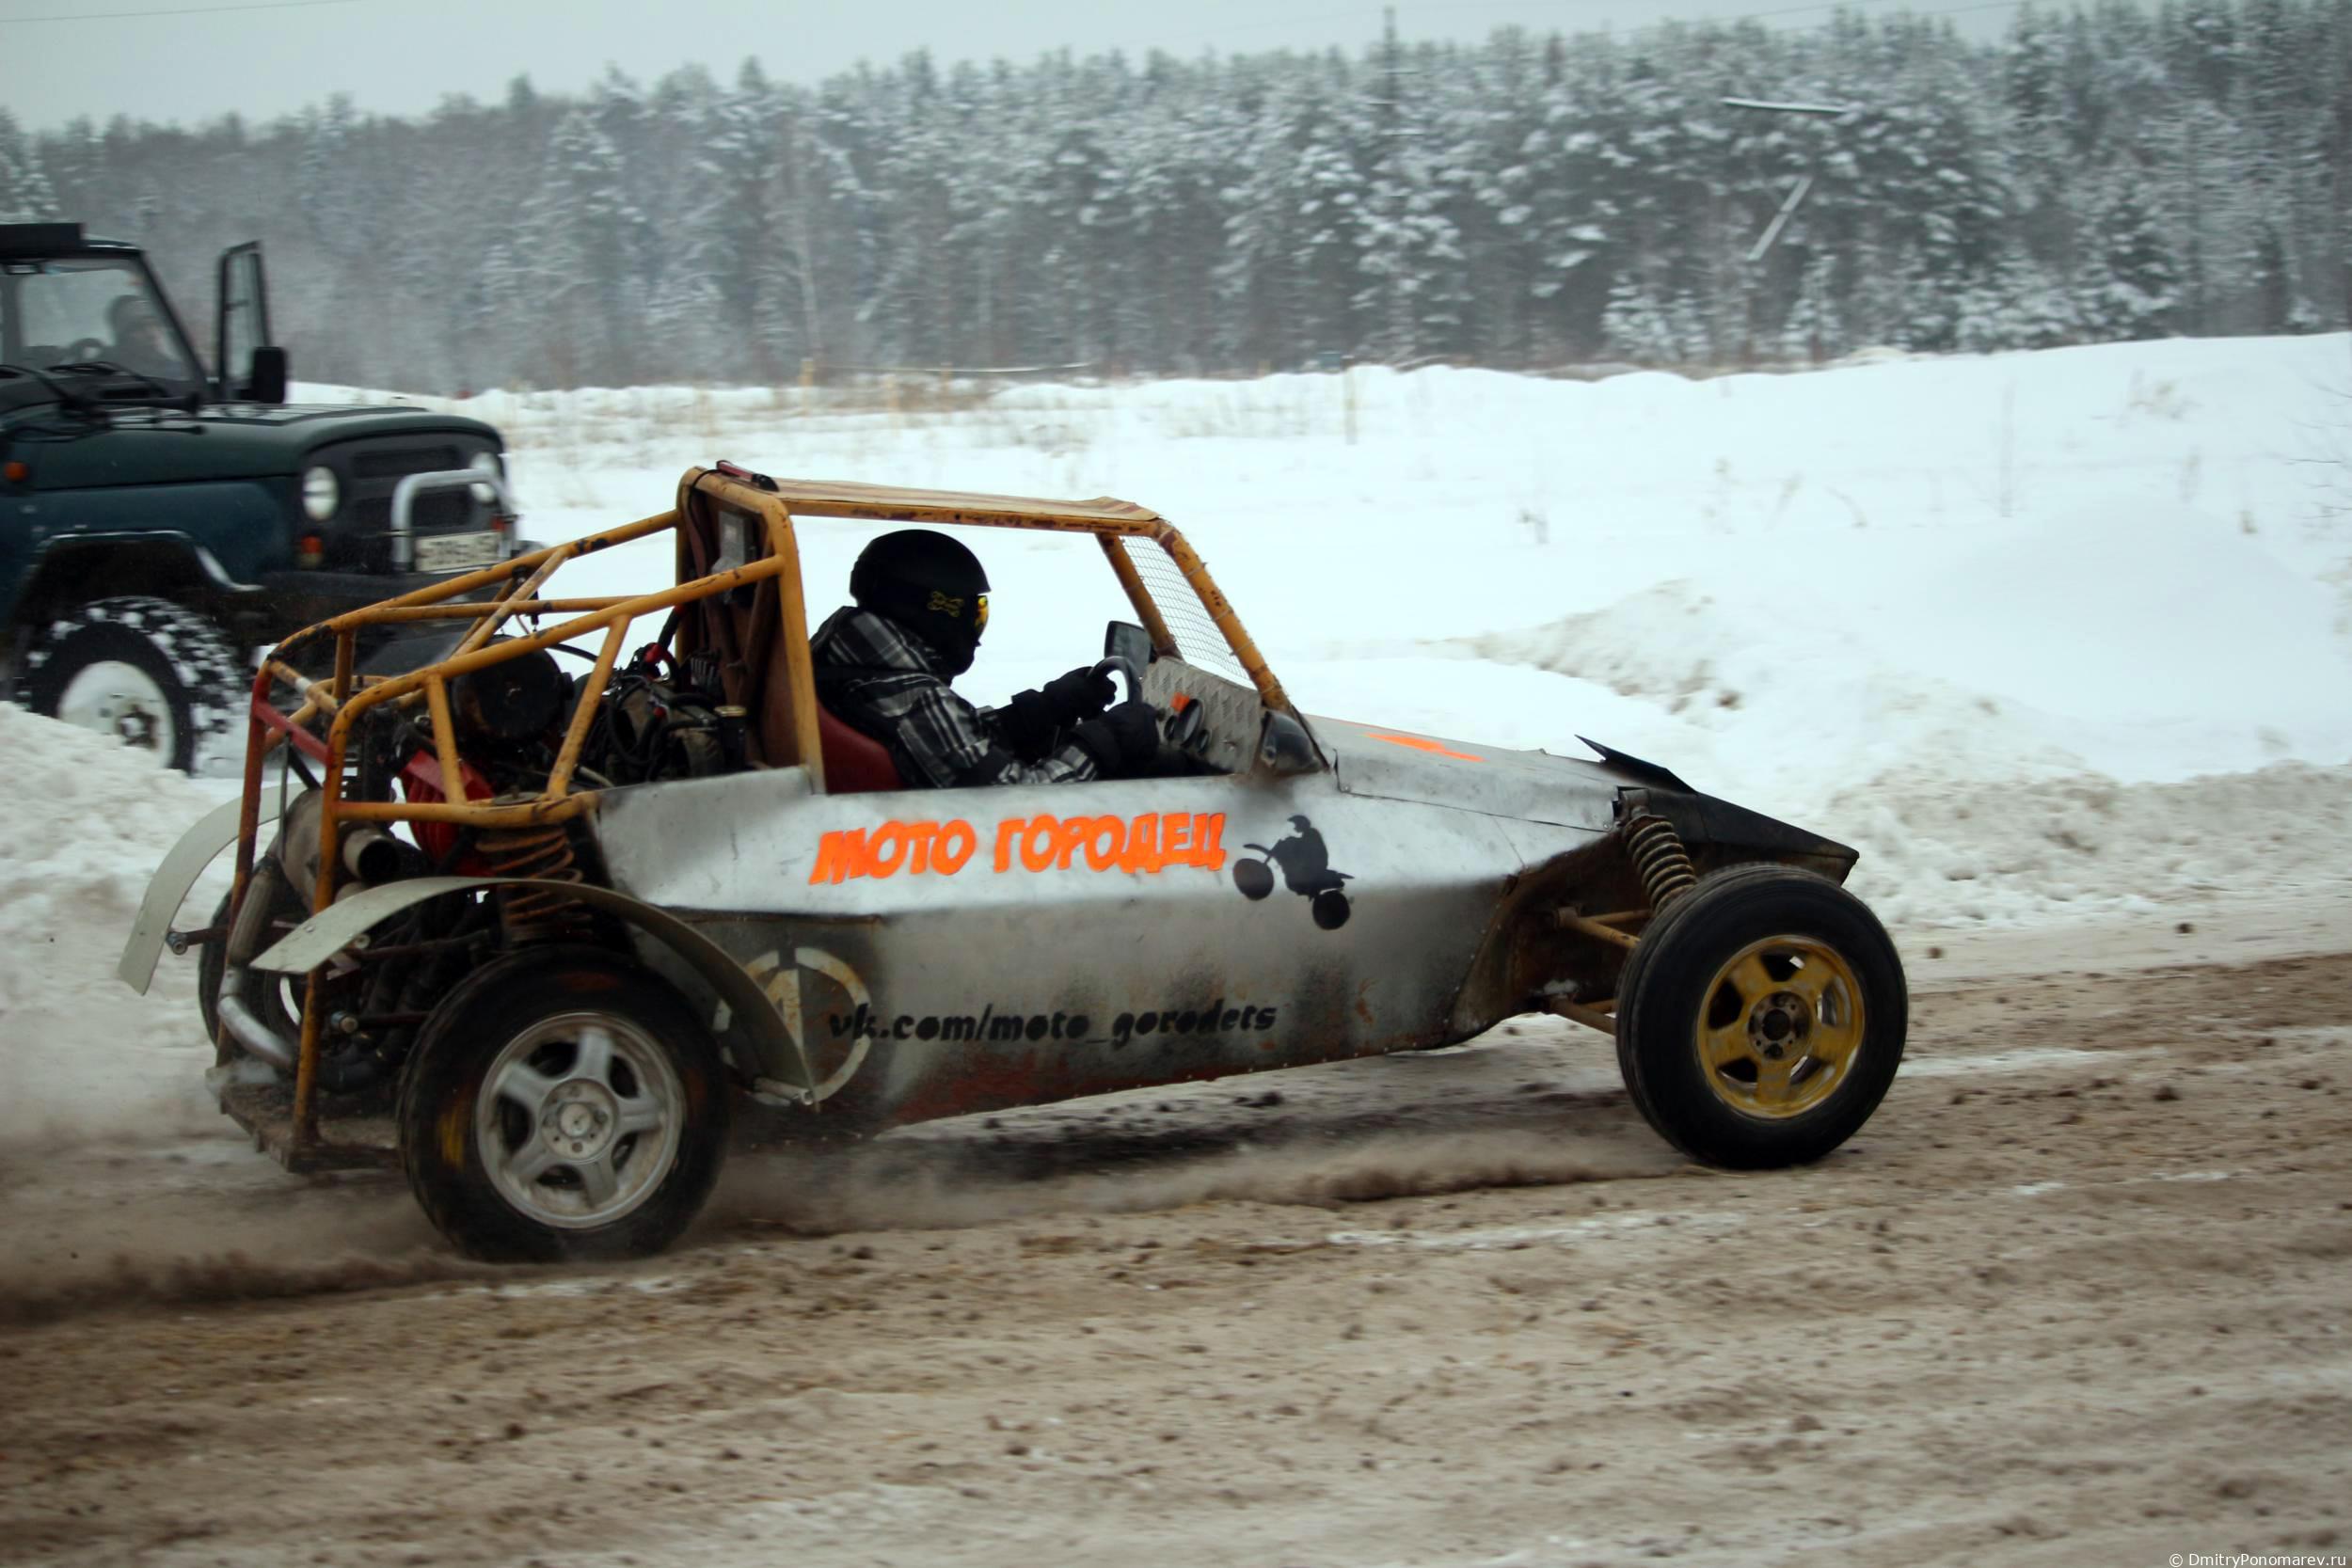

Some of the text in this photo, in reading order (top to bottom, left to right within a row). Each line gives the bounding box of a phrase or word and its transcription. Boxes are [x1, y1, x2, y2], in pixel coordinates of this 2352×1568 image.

[809, 812, 1227, 884] МОТО ГОРОДЕЦ
[829, 999, 1277, 1050] vk.com/moto_gorodets
